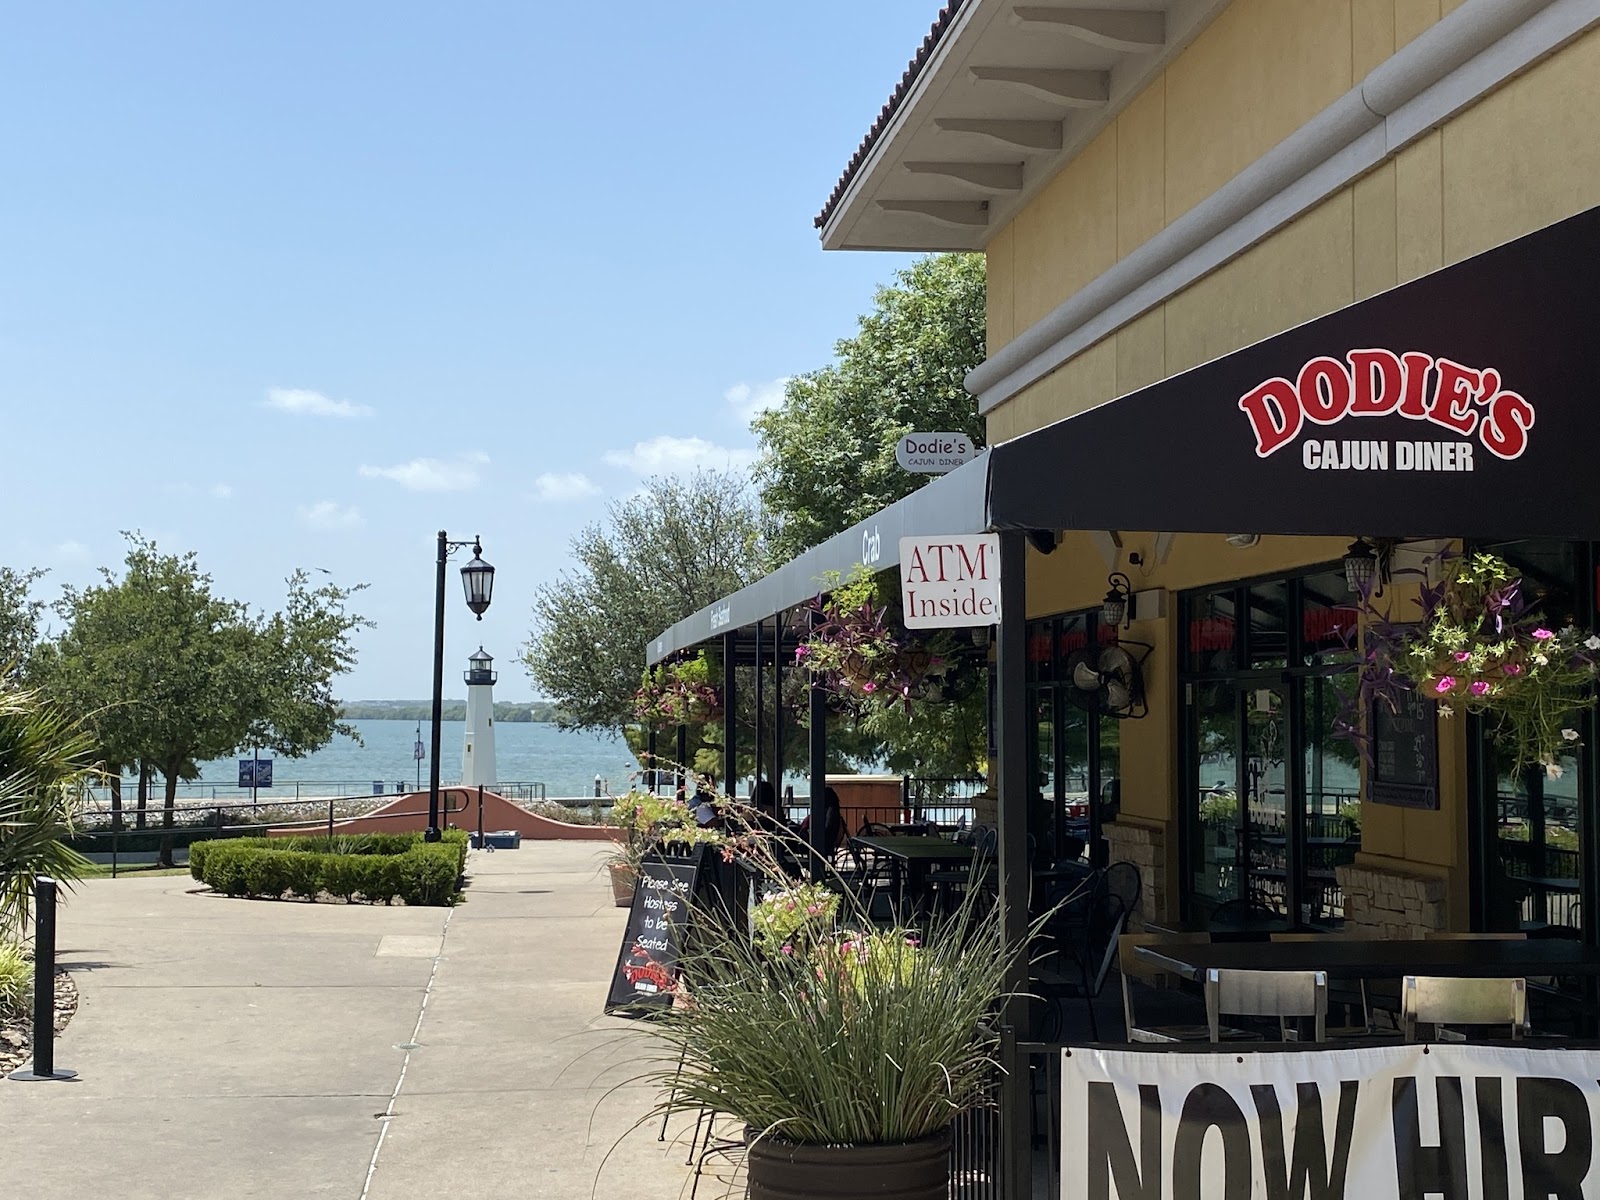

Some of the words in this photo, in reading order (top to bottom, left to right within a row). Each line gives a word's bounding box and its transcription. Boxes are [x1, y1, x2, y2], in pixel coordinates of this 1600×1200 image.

[1238, 348, 1535, 460] DODIE'S
[905, 438, 966, 454] Dodie's
[1302, 439, 1389, 470] CAJUN
[1395, 441, 1474, 472] DINER
[908, 458, 935, 466] CAJUN
[939, 458, 964, 466] DINER
[862, 525, 880, 566] Crab
[906, 543, 989, 584] ATM
[908, 588, 993, 618] Inside
[641, 875, 669, 890] Please
[670, 878, 689, 892] See
[643, 895, 679, 912] Hostess
[644, 915, 654, 929] to
[655, 916, 669, 931] be
[635, 934, 669, 951] Seated
[1088, 1080, 1360, 1200] NOW
[1391, 1076, 1600, 1200] HIR
